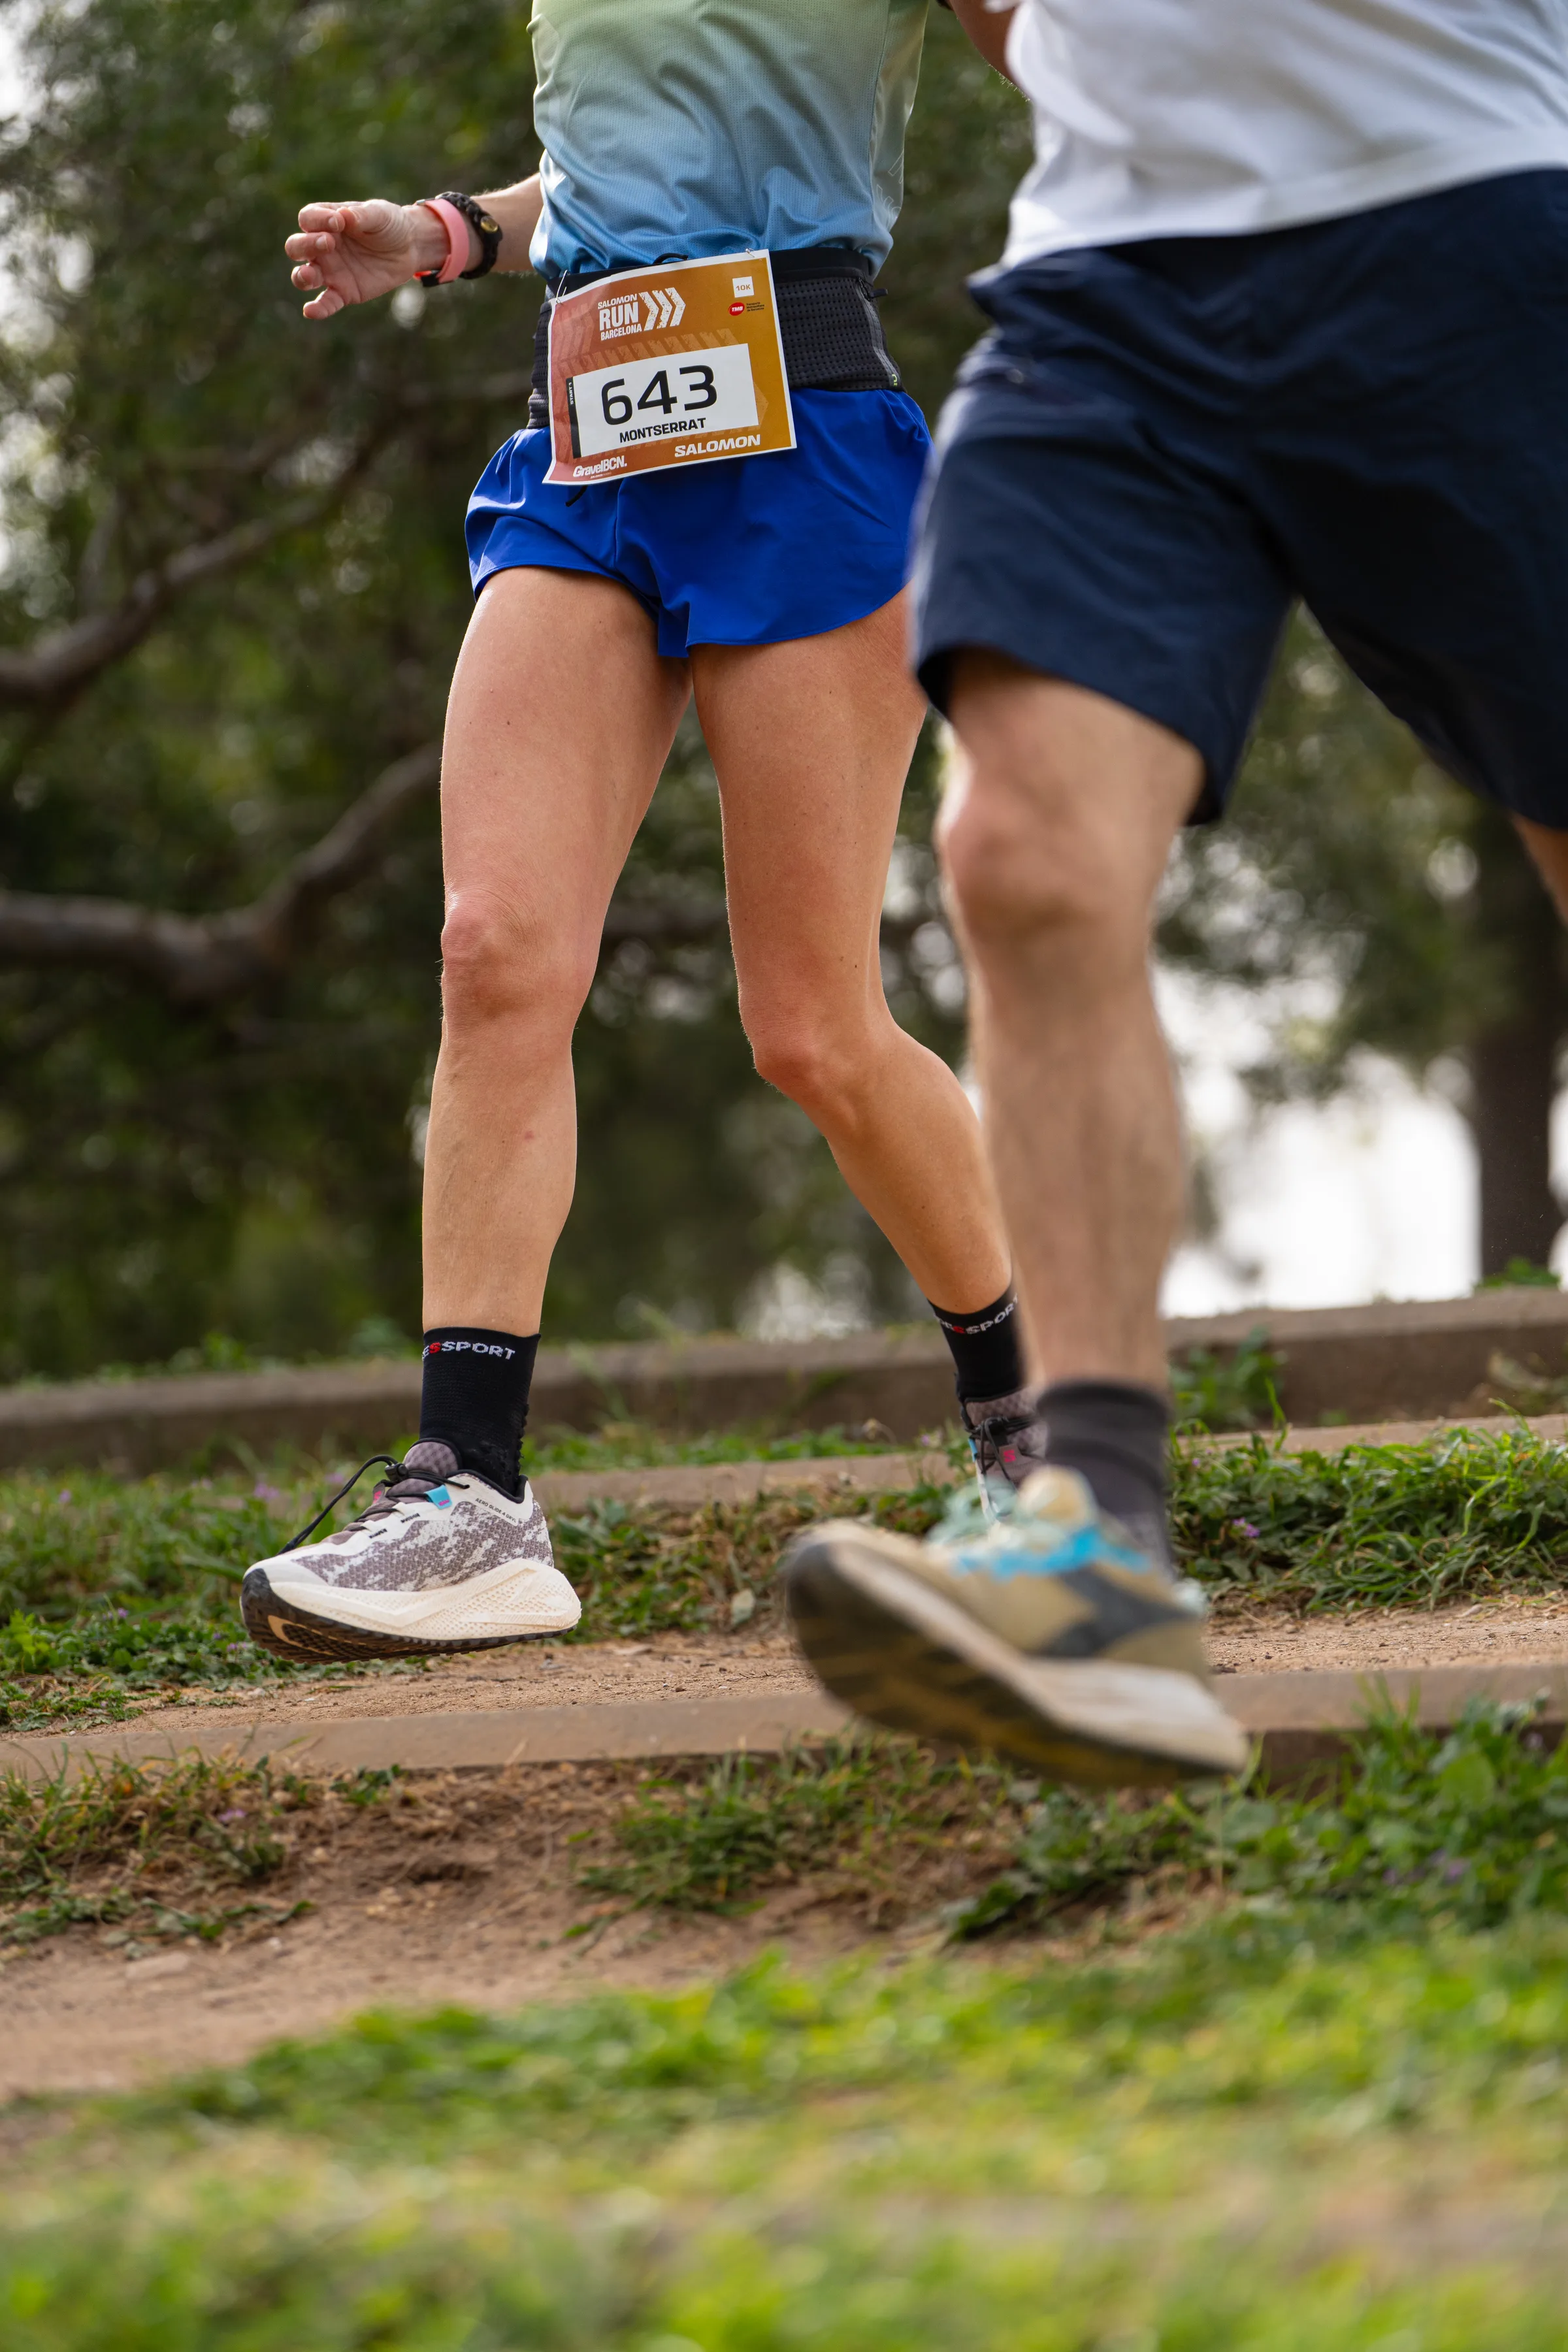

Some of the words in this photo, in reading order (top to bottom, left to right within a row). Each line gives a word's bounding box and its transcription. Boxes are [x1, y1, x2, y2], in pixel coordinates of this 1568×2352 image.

[598, 293, 638, 309] SALOMON
[599, 305, 640, 331] RUN
[600, 323, 642, 341] BARCELONA
[601, 365, 717, 426] 643
[619, 417, 706, 444] MONTSERRAT
[674, 434, 761, 457] SALOMON
[475, 1497, 489, 1507] AERO
[489, 1505, 502, 1513] GLIDE
[505, 1514, 517, 1523] GRVL
